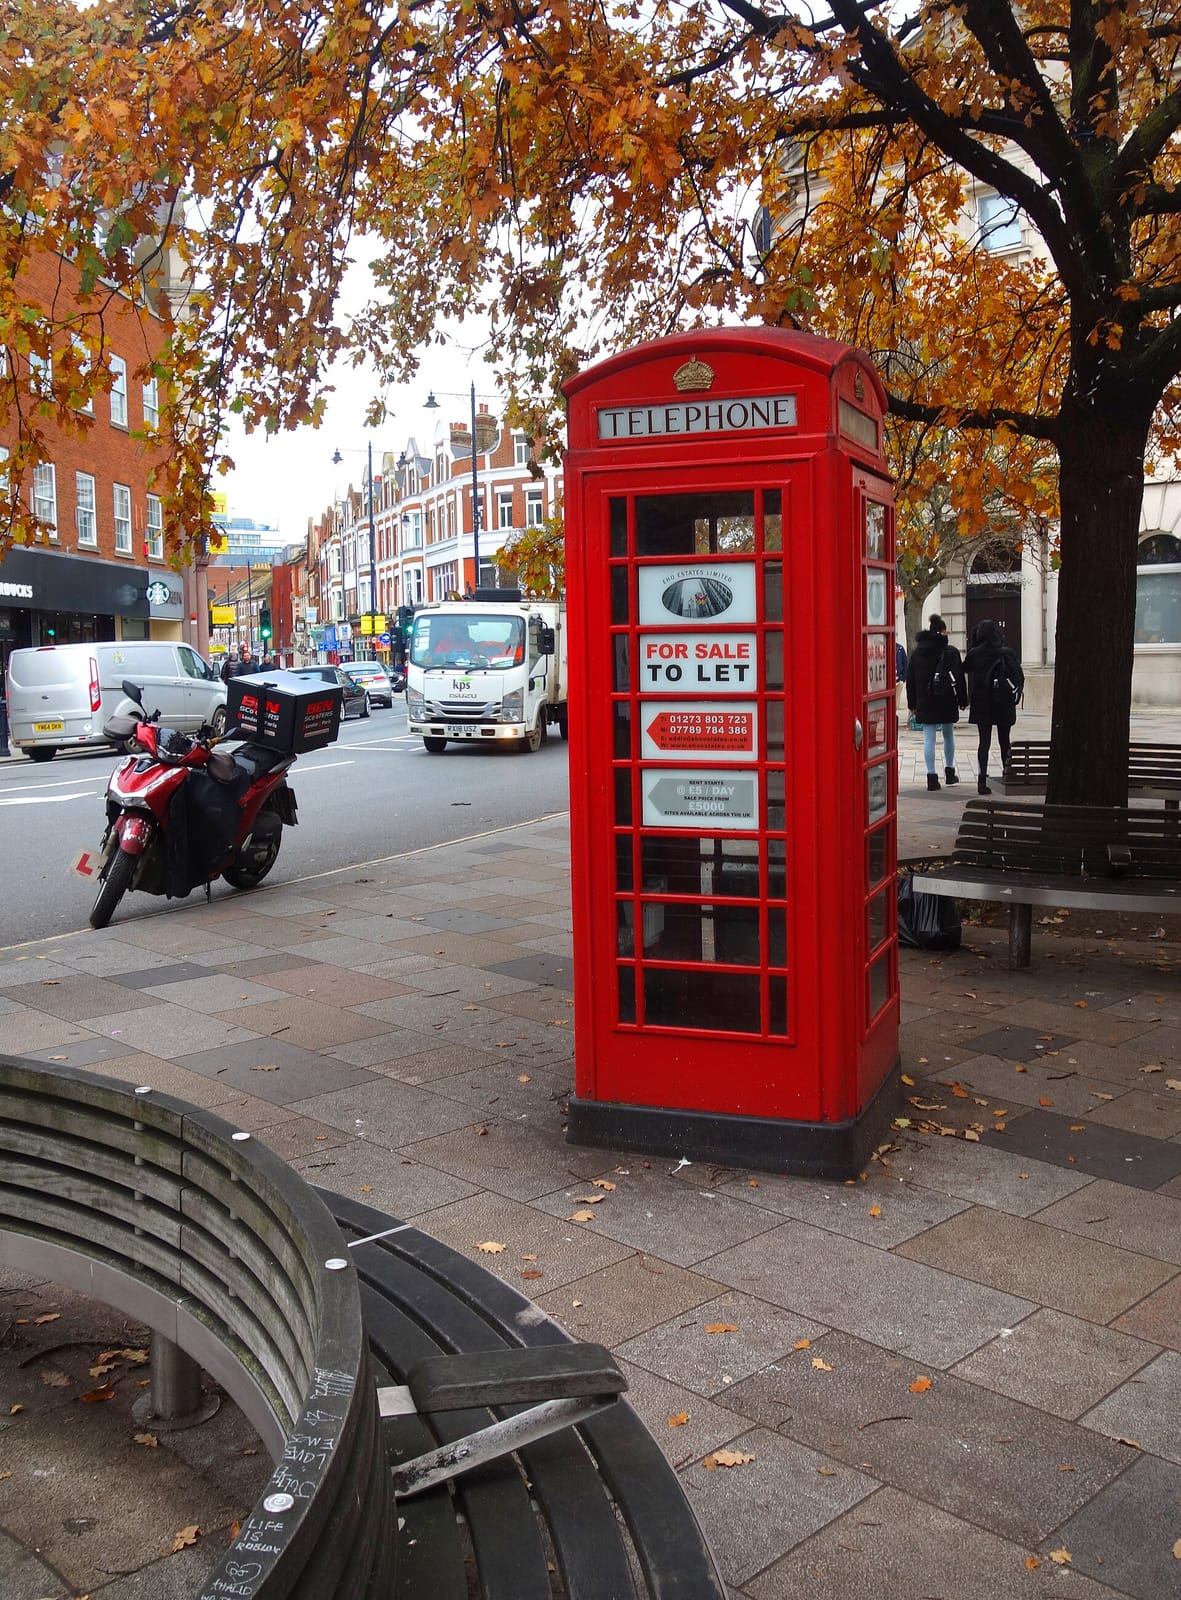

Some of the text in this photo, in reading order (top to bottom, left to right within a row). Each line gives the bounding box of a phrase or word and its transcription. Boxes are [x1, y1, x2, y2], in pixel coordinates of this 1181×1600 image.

[605, 399, 790, 436] TELEPHONE
[677, 569, 704, 578] ESTATES
[706, 570, 732, 582] LIMITED
[646, 643, 750, 659] FOR SALE
[647, 664, 750, 682] TO LET
[453, 678, 471, 692] kps
[670, 715, 702, 724] 01273
[705, 715, 724, 724] 803
[728, 715, 747, 724] 723
[670, 726, 702, 734] 07789
[705, 726, 724, 734] 784
[728, 726, 747, 735] 386
[688, 785, 702, 795] £5
[712, 786, 735, 795] DAY
[688, 801, 725, 811] £5000
[248, 1518, 284, 1532] LIFE
[244, 1530, 263, 1542] IS
[235, 1542, 281, 1554] ROBLOX
